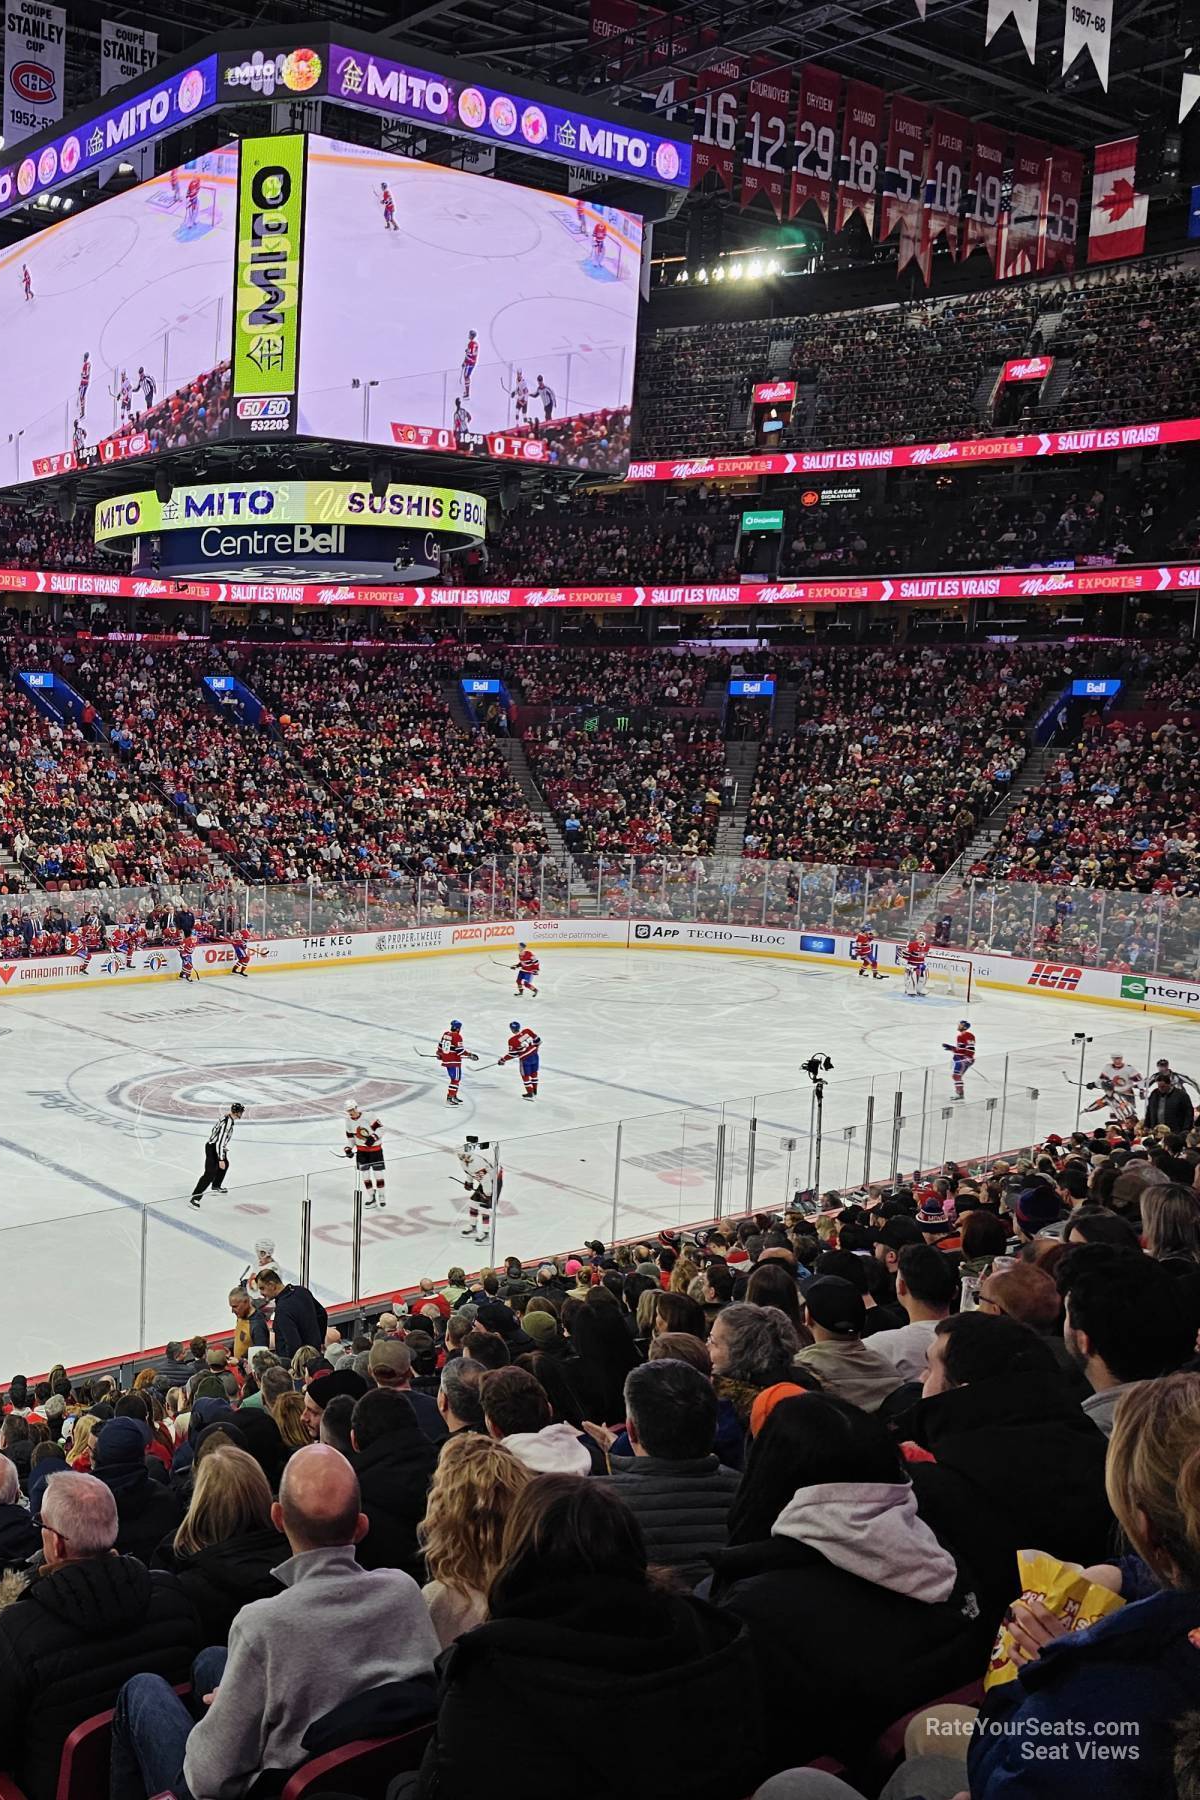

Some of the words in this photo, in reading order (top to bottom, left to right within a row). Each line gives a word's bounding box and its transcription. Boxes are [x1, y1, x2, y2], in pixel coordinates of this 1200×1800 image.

[21, 2, 52, 20] COUPE
[1071, 6, 1106, 33] 1967-68
[7, 16, 64, 44] STANLEY
[116, 28, 145, 44] COUPE
[26, 40, 45, 53] CUP
[103, 37, 156, 67] STANLEY
[120, 64, 138, 77] CUP
[366, 63, 449, 114] MITO
[806, 92, 833, 112] DRYDEN
[106, 92, 169, 148] MITO
[704, 92, 737, 149] 16
[852, 108, 876, 128] SAVARD
[579, 123, 647, 168] MITO
[750, 111, 785, 173] 12
[798, 120, 834, 181] 29
[938, 132, 963, 152] LAFLEUR
[847, 136, 878, 193] 18
[934, 159, 961, 212] 10
[974, 172, 999, 225] 19
[240, 401, 286, 416] 50/50
[250, 419, 290, 431] 53220$
[438, 431, 448, 447] 0
[494, 438, 504, 454] 0
[910, 446, 957, 464] Molson
[962, 441, 1009, 457] EXPORT
[671, 461, 714, 478] Molson
[718, 461, 759, 474] EXPORT
[185, 490, 274, 518] MITO
[347, 492, 444, 519] SUSHIS
[449, 501, 462, 520] &
[100, 501, 141, 531] MITO
[51, 574, 77, 591] SALUT
[78, 577, 93, 592] LES
[94, 578, 120, 593] VRAIS!
[133, 580, 166, 597] Molson
[901, 582, 935, 597] SALUT
[938, 581, 959, 596] LES
[961, 577, 1000, 594] VRAIS!
[1020, 575, 1073, 595] Molson
[1078, 577, 1126, 588] EXPORT
[231, 585, 256, 600] SALUT
[258, 586, 274, 602] LES
[276, 586, 304, 602] VRAIS!
[318, 587, 355, 604] Molson
[358, 592, 393, 601] EXPORT
[431, 589, 458, 604] SALUT
[459, 590, 478, 604] LES
[480, 590, 510, 606] VRAIS!
[525, 588, 565, 606] Molson
[569, 593, 609, 602] EXPORT
[651, 589, 683, 604] SALUT
[685, 589, 704, 603] LES
[706, 588, 739, 601] VRAIS!
[757, 584, 804, 603] Molson
[809, 588, 853, 597] EXPORT
[29, 674, 44, 686] Bell
[212, 678, 226, 689] Bell
[472, 680, 489, 692] Bell
[743, 682, 761, 694] Bell
[1086, 682, 1106, 694] Bell
[533, 921, 558, 929] Scotia
[303, 938, 325, 948] THE
[331, 936, 352, 946] KEG
[452, 928, 481, 944] pizza
[485, 926, 515, 942] pizza
[20, 966, 64, 979] CANADIAN
[1028, 963, 1083, 991] IGA
[312, 1204, 450, 1247] CIBC
